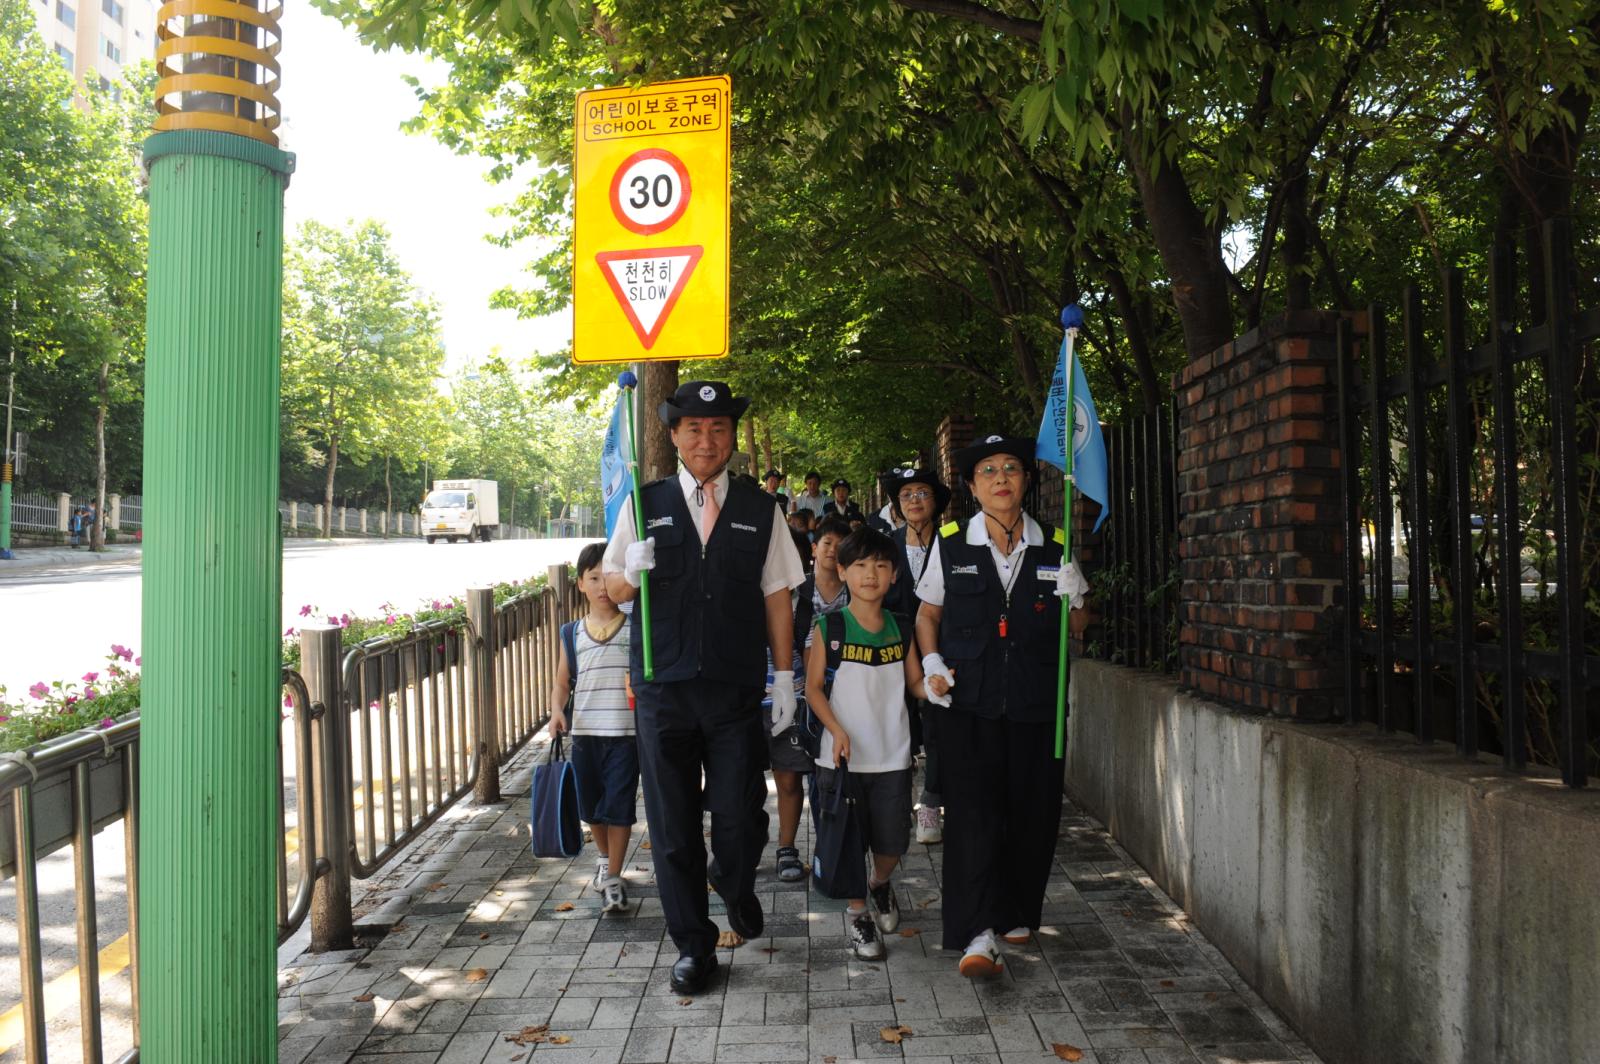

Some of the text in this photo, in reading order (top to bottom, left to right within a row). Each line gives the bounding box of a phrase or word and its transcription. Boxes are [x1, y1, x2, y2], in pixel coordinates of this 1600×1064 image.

[589, 93, 717, 121] 어린이보호구역
[592, 114, 713, 135] SCHOOL ZONE
[629, 174, 673, 209] 30
[625, 259, 672, 284] 천천히
[629, 285, 668, 301] SLOW
[880, 644, 904, 663] SPO
